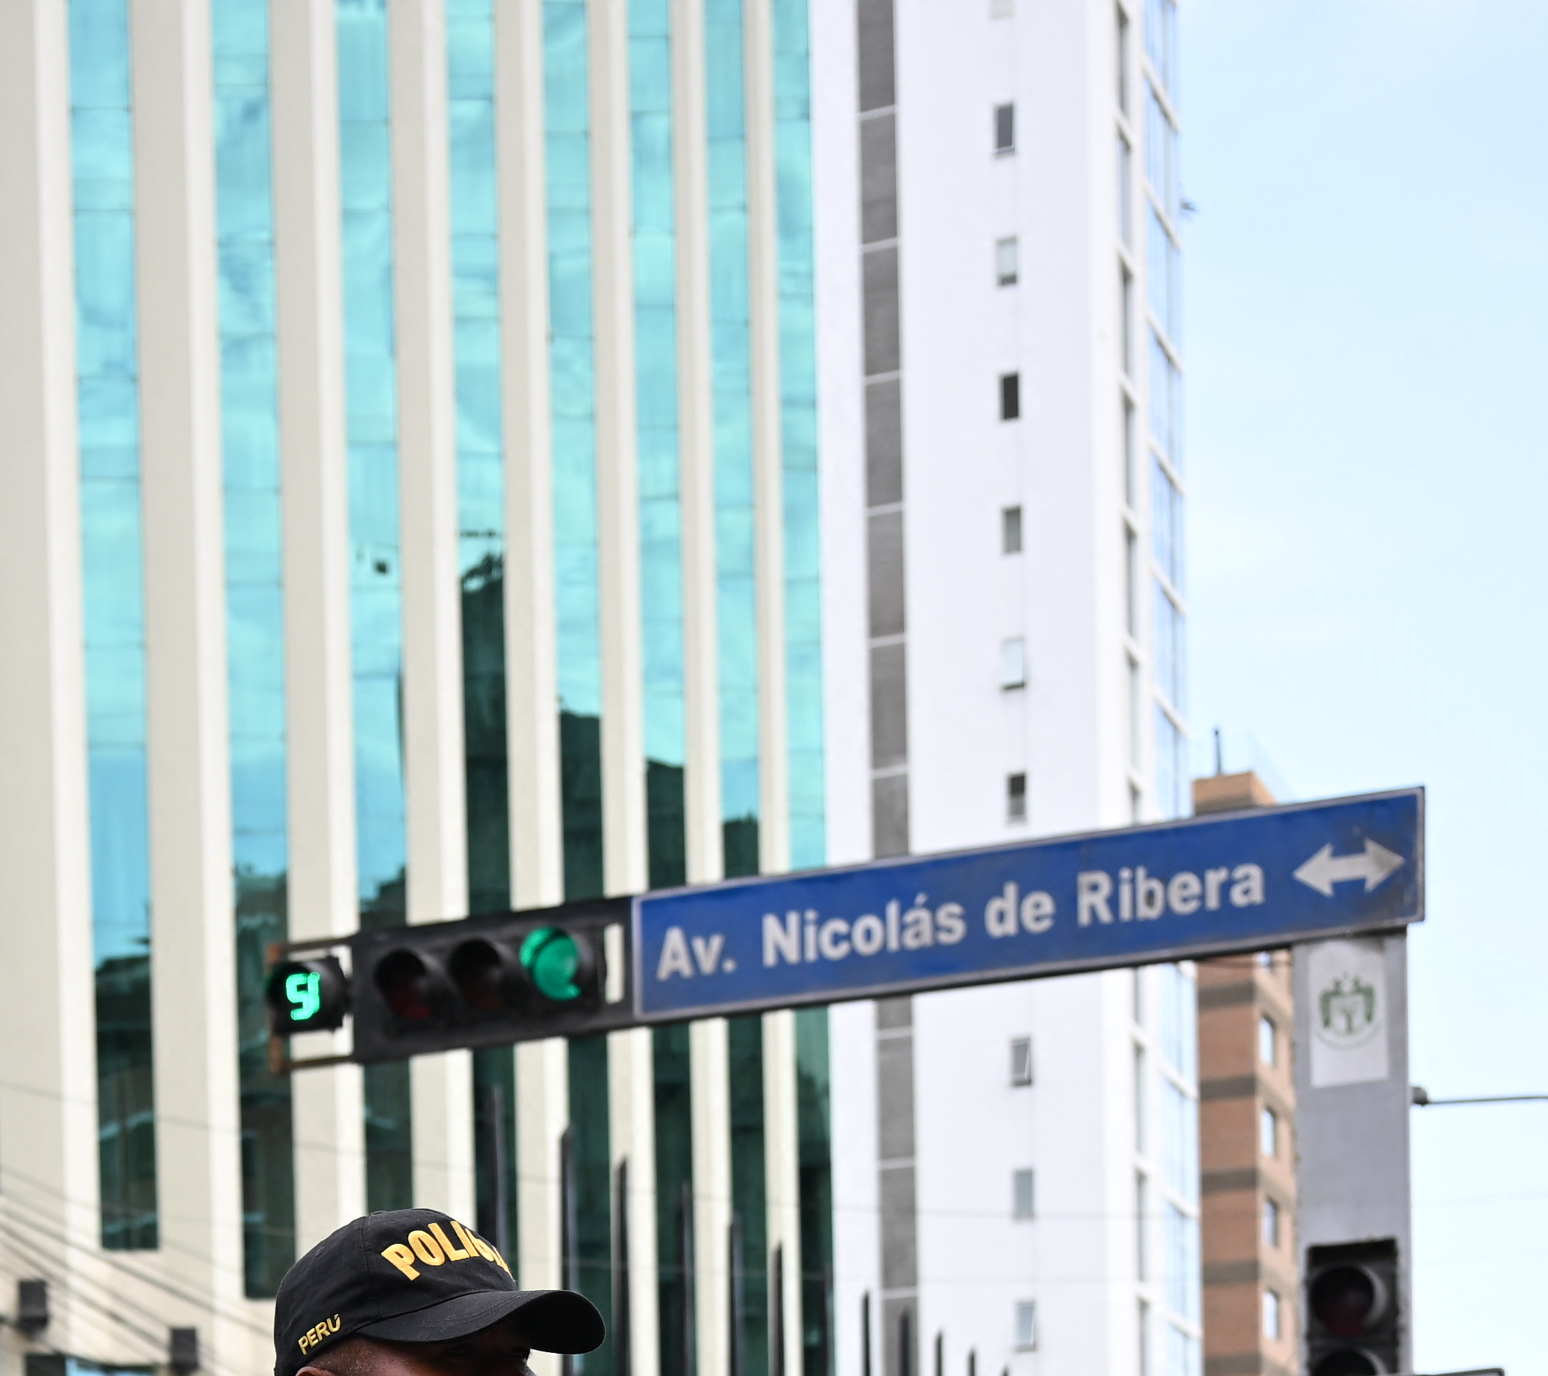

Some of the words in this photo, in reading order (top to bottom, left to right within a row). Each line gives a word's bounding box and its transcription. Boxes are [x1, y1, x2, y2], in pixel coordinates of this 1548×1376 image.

[656, 926, 736, 982] Av.
[761, 893, 967, 968] Nicolás
[983, 882, 1055, 939] de
[1076, 863, 1266, 927] Ribera
